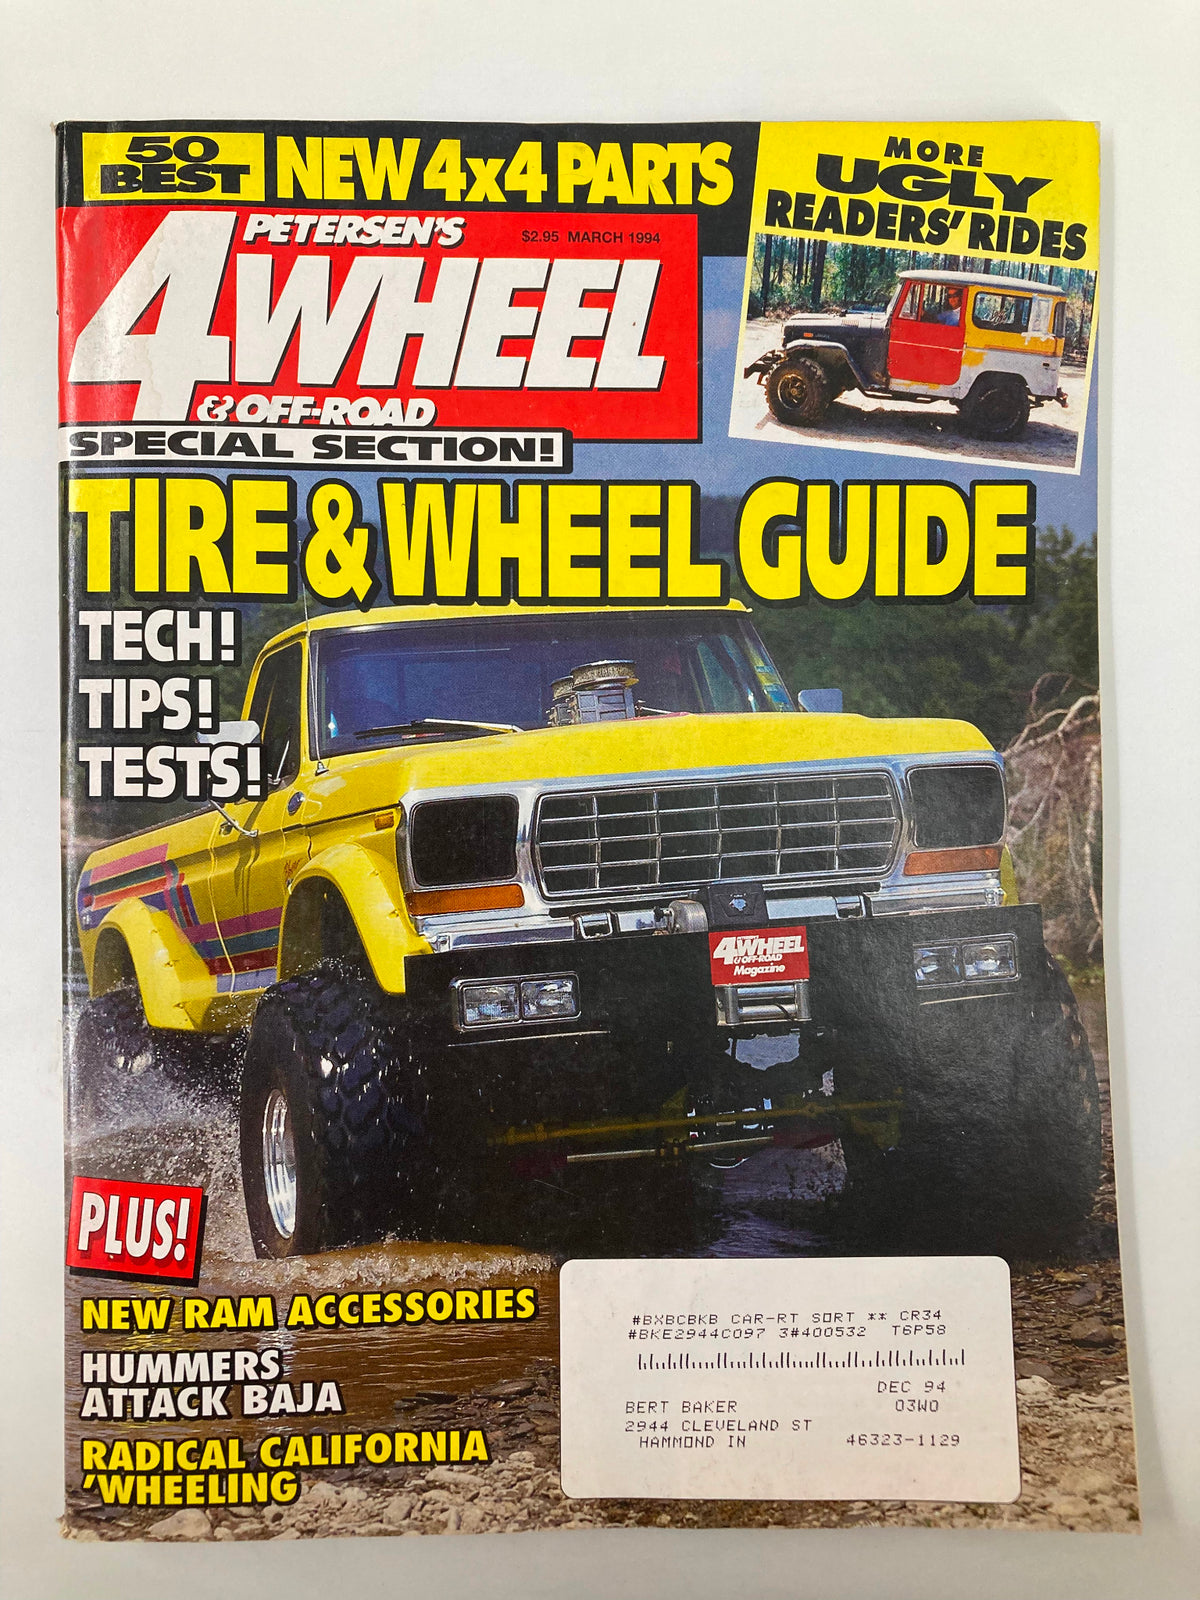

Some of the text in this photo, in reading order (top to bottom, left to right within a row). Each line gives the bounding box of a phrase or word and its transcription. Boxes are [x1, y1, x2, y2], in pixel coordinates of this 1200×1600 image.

[100, 136, 250, 194] 50 BEST
[884, 136, 984, 168] MORE
[276, 136, 733, 206] NEW 4x4 PARTS
[815, 153, 1052, 213] UGLY
[243, 214, 466, 247] PETERSEN'S
[522, 230, 661, 244] $2.95 MARCH 1994
[764, 189, 1088, 261] READERS' RIDES
[235, 395, 436, 427] OFF-ROAD
[69, 430, 555, 462] SPECIAL SECTION!
[68, 478, 1028, 602] TIRE & WHEEL GUIDE
[78, 610, 235, 662] TECH!
[78, 678, 213, 731] TIPS!
[78, 746, 261, 798] TESTS!
[734, 963, 785, 977] Magazine
[78, 1191, 190, 1262] PLUS!
[83, 1288, 536, 1330] NEW RAM ACCESSORIES
[632, 1314, 718, 1326] #BXBCBKB
[731, 1313, 798, 1325] CAR-RT
[812, 1312, 855, 1323] SORT
[900, 1310, 942, 1321] CR34
[779, 1326, 867, 1339] 3#400532
[892, 1324, 946, 1336] T6P58
[83, 1350, 280, 1383] HUMMERS
[81, 1382, 343, 1418] ATTACK BAJA
[877, 1381, 946, 1393] DEC 94
[625, 1400, 738, 1414] BERT BAKER
[625, 1419, 813, 1432] 2944 CLEVELAND ST
[639, 1435, 746, 1448] HAMMOND IN
[846, 1434, 960, 1446] 46323-1129
[83, 1430, 488, 1471] RADICAL CALIFORNIA
[83, 1471, 298, 1505] 'WHEELING
